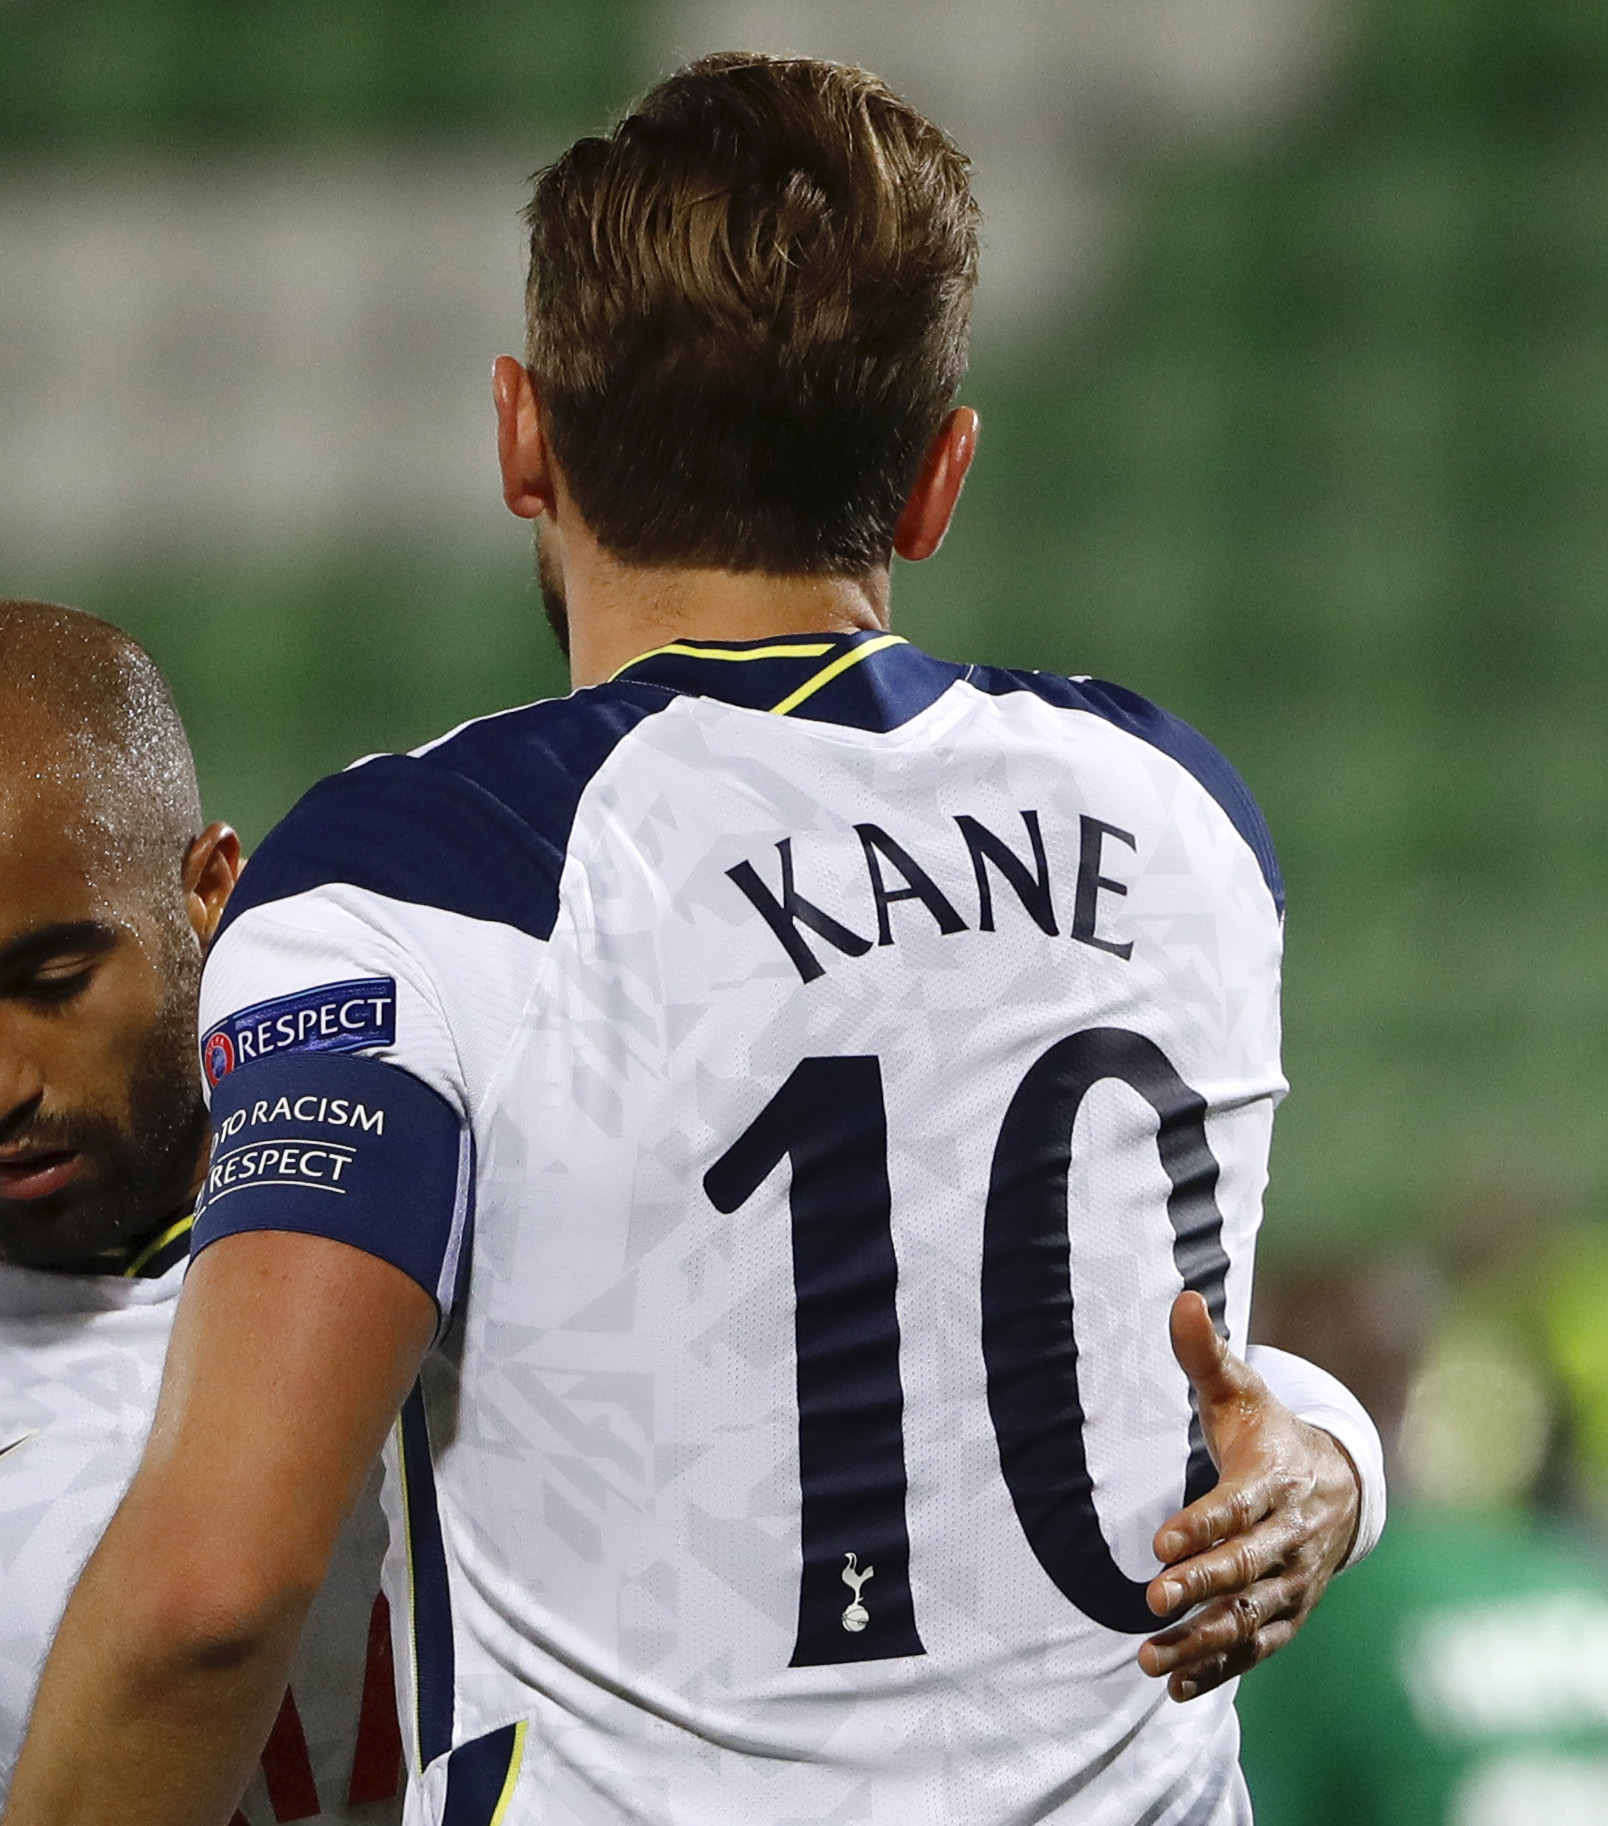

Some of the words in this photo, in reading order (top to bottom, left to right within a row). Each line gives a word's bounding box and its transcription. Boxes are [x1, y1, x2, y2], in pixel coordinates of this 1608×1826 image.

[725, 809, 1137, 985] KANE
[237, 998, 392, 1063] RESPECT
[220, 1109, 247, 1144] TO
[251, 1096, 385, 1136] RACISM
[209, 1149, 353, 1194] RESPECT
[702, 1026, 1231, 1668] 10
